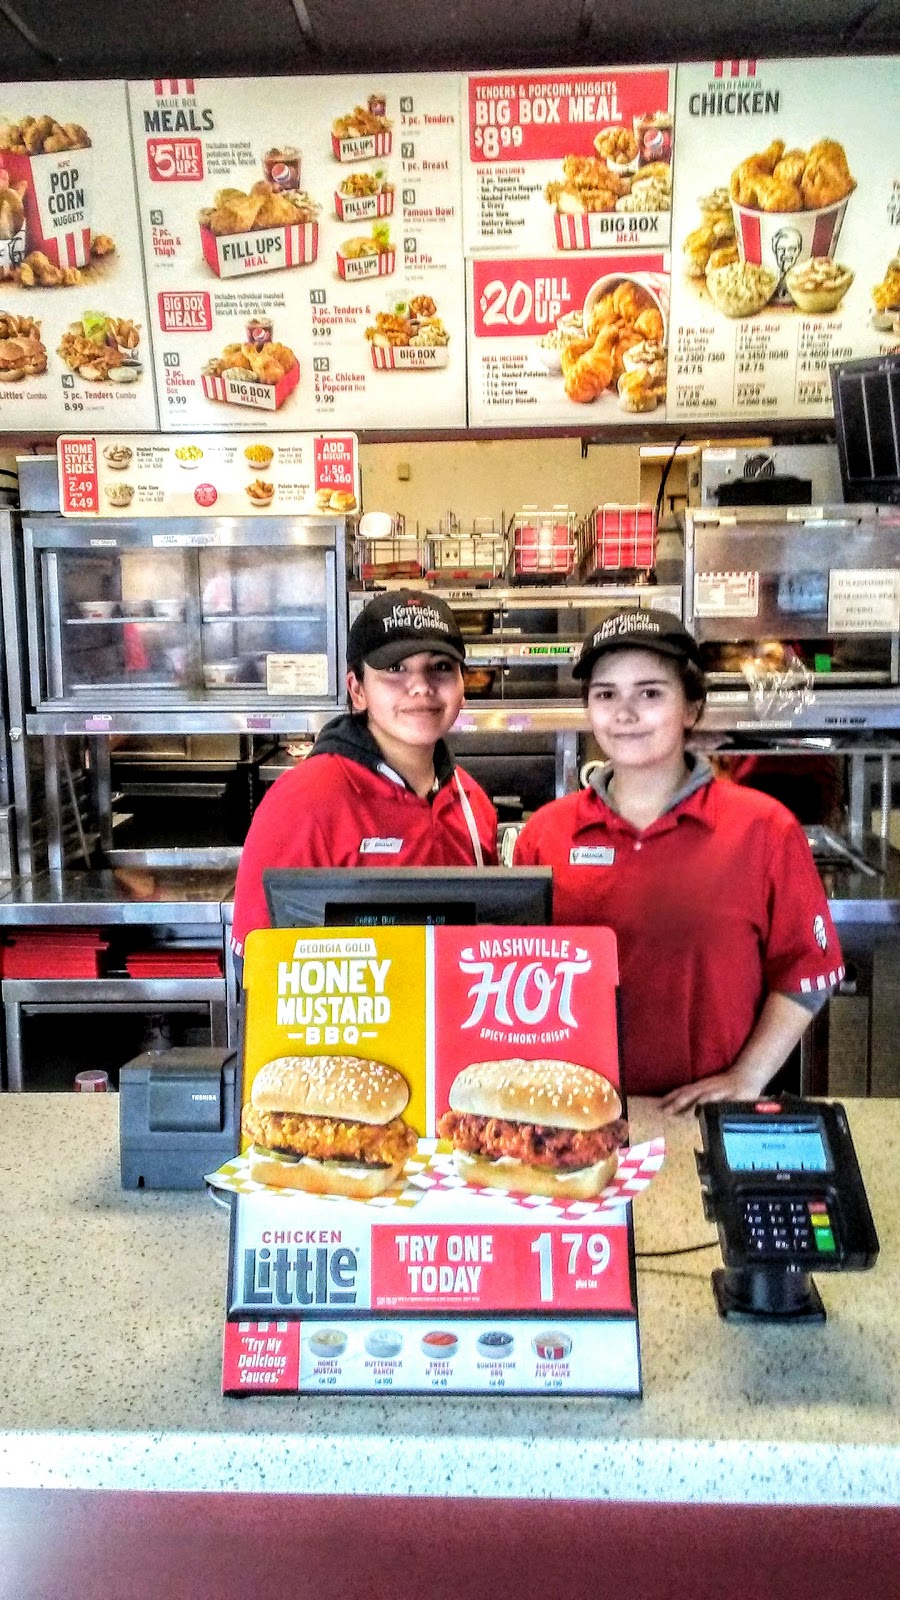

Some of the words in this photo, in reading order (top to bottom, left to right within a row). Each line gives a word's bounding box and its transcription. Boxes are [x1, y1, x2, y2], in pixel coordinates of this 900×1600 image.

[476, 86, 516, 99] TENDERS
[518, 85, 526, 98] &
[528, 83, 572, 97] POPCORN
[574, 81, 618, 96] NUGGETS
[708, 80, 731, 91] WORLD
[734, 79, 762, 90] FAMOUS
[156, 99, 178, 108] VALUE
[182, 98, 197, 107] BOX
[688, 90, 780, 116] CHICKEN
[476, 100, 510, 125] BIG
[519, 98, 560, 124] BOX
[568, 95, 622, 122] MEAL
[143, 109, 214, 132] MEALS
[408, 116, 420, 126] pc.
[423, 114, 454, 124] Tenders
[342, 142, 358, 154] FILL
[360, 140, 374, 150] UPS
[150, 144, 175, 177] $5
[175, 146, 198, 160] FILL
[408, 162, 420, 172] pc.
[422, 160, 448, 170] Breast
[177, 160, 198, 174] UPS
[51, 169, 79, 193] POP
[48, 188, 85, 214] CORN
[345, 202, 361, 213] FILL
[362, 200, 376, 210] UPS
[403, 207, 432, 216] Famous
[436, 206, 454, 216] Bowl
[53, 212, 84, 228] NUGGETS
[600, 218, 624, 232] BIG
[629, 216, 658, 231] BOX
[160, 229, 171, 237] pc.
[616, 232, 640, 242] MEAL
[152, 237, 174, 246] Drum
[154, 246, 175, 257] Thigh
[222, 242, 254, 261] FILL
[256, 237, 282, 254] UPS
[244, 256, 268, 268] MEAL
[404, 255, 417, 263] Pot
[420, 254, 432, 262] Pie
[348, 262, 362, 272] FILL
[364, 260, 377, 269] UPS
[534, 277, 570, 300] FILL
[164, 298, 180, 310] BIG
[183, 297, 205, 310] BOX
[320, 307, 330, 316] pc.
[334, 306, 362, 314] Tenders
[534, 300, 560, 323] UP
[165, 310, 206, 326] MEALS
[312, 316, 342, 325] Popcorn
[312, 328, 332, 336] 9.99
[400, 350, 415, 358] BIG
[418, 350, 436, 358] BOX
[173, 370, 184, 378] pc.
[322, 374, 333, 382] pc.
[336, 373, 365, 381] Chicken
[166, 378, 196, 386] Chicken
[322, 384, 352, 392] Popcorn
[84, 391, 113, 399] Tenders
[230, 383, 248, 394] BIG
[250, 386, 271, 398] BOX
[241, 396, 258, 404] MEAL
[315, 394, 334, 402] 9.99
[64, 403, 84, 411] 8.99
[64, 444, 92, 454] HOME
[323, 442, 344, 452] ADD
[64, 454, 93, 464] STYLE
[323, 452, 350, 460] BISCUITS
[65, 464, 94, 474] SIDES
[324, 465, 344, 474] 1.50
[320, 474, 333, 482] Cal.
[334, 474, 352, 483] 360
[69, 482, 92, 492] 2.49
[70, 498, 93, 508] 4.49
[392, 604, 440, 620] Kentucky
[382, 614, 411, 632] Fried
[414, 614, 449, 632] Chicken
[618, 620, 660, 634] Chicken
[382, 916, 395, 925] OUT
[300, 943, 342, 954] GEORGIA
[346, 942, 370, 953] GOLD
[480, 938, 570, 958] NASHVILLE
[277, 960, 392, 995] HONEY
[459, 960, 592, 1030] HOT
[277, 996, 392, 1026] MUSTARD
[262, 1230, 342, 1244] CHICKEN
[394, 1235, 438, 1262] TRY
[446, 1234, 493, 1262] ONE
[243, 1247, 358, 1304] Little
[408, 1265, 482, 1294] TODAY
[266, 1338, 282, 1354] My
[238, 1354, 286, 1368] Delicious
[373, 1368, 394, 1376] RANCH
